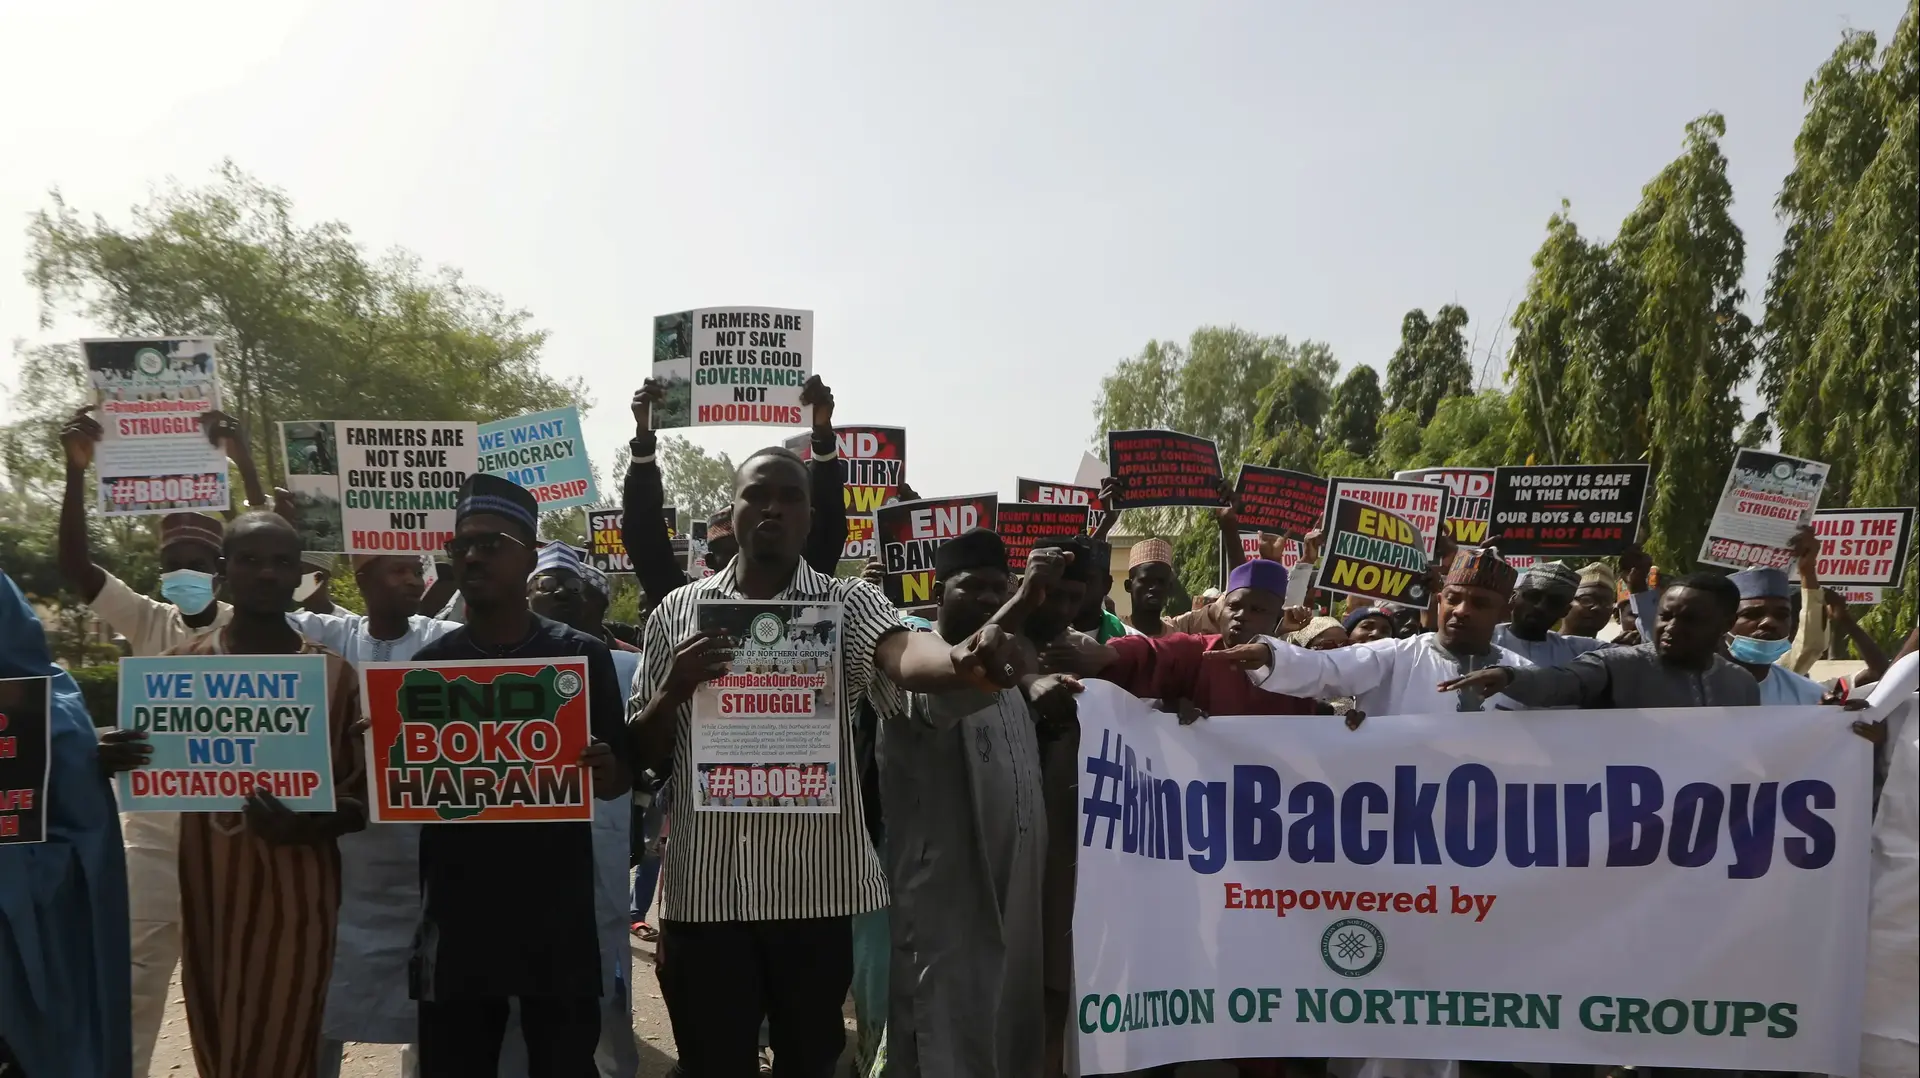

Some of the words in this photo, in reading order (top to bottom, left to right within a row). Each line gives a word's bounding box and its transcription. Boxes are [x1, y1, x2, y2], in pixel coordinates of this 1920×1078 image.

[701, 312, 771, 329] FARMERS
[774, 314, 802, 331] ARE
[716, 331, 746, 347] NOT
[749, 332, 787, 348] SAVE
[699, 350, 733, 367] GIVE
[737, 350, 757, 365] US
[760, 350, 802, 368] GOOD
[695, 367, 806, 387] GOVERNANCE
[734, 387, 768, 403] NOT
[698, 404, 802, 424] HOODLUMS
[119, 417, 201, 436] STRUGGLE
[477, 432, 506, 451] WE
[510, 420, 564, 444] WANT
[346, 428, 427, 446] FARMERS
[431, 429, 464, 446] ARE
[836, 433, 879, 458] ND
[366, 450, 399, 467] NOT
[404, 450, 447, 467] SAVE
[1119, 452, 1131, 461] IN
[348, 470, 386, 487] GIVE
[392, 471, 413, 488] US
[418, 471, 466, 488] GOOD
[507, 466, 546, 486] NOT
[1118, 464, 1178, 476] APPALLING
[113, 474, 217, 503] #BBOB#
[1129, 477, 1142, 487] OF
[1146, 476, 1204, 486] STATECRAFT
[1509, 474, 1575, 487] NOBODY
[1577, 474, 1591, 486] IS
[1594, 474, 1631, 486] SAFE
[346, 490, 458, 509] GOVERNANC
[529, 480, 588, 503] ORSHIP
[1038, 485, 1089, 505] END
[1125, 488, 1173, 500] EMOCRACY
[1280, 488, 1325, 506] CONDITIO
[1515, 489, 1532, 501] IN
[1536, 489, 1564, 501] THE
[1567, 489, 1620, 501] NORTH
[1412, 494, 1439, 512] THE
[1738, 501, 1799, 521] STRUGGLE
[390, 513, 428, 529] NOT
[592, 515, 624, 530] STO
[911, 505, 978, 539] END
[1357, 508, 1414, 544] END
[1496, 512, 1527, 523] OUR
[1531, 512, 1569, 524] BOYS
[1573, 512, 1585, 524] &
[1589, 512, 1633, 524] GIRLS
[1860, 519, 1898, 536] THE
[1004, 524, 1023, 533] BAD
[1026, 525, 1079, 535] CONDITION
[1503, 528, 1534, 539] ARE
[1541, 528, 1577, 539] NOT
[1581, 528, 1622, 539] SAFE
[352, 531, 455, 550] HOODLUM
[596, 545, 609, 554] IN
[1840, 539, 1893, 556] STOP
[1712, 539, 1792, 568] #BBOB#
[1872, 559, 1893, 576] IT
[1331, 559, 1412, 597] NOW
[145, 673, 193, 699] WE
[204, 673, 299, 699] WANT
[708, 673, 825, 689] #BringBackOurBoys#
[406, 683, 545, 719] END
[722, 693, 812, 713] STRUGGLE
[133, 706, 311, 733] DEMOCRACY
[403, 719, 561, 764] BOKO
[188, 738, 256, 765] NOT
[131, 771, 320, 797] DICTATORSHIP
[385, 766, 584, 808] HARAM
[710, 766, 826, 797] #BBOB#
[1083, 728, 1836, 879] #BringBackOurBoys
[1224, 882, 1437, 917] Empowered
[1451, 886, 1496, 922] by
[1078, 988, 1214, 1034] COALITION
[1228, 987, 1282, 1025] OF
[1295, 988, 1562, 1030] NORTHERN
[1579, 995, 1798, 1038] GROUPS
